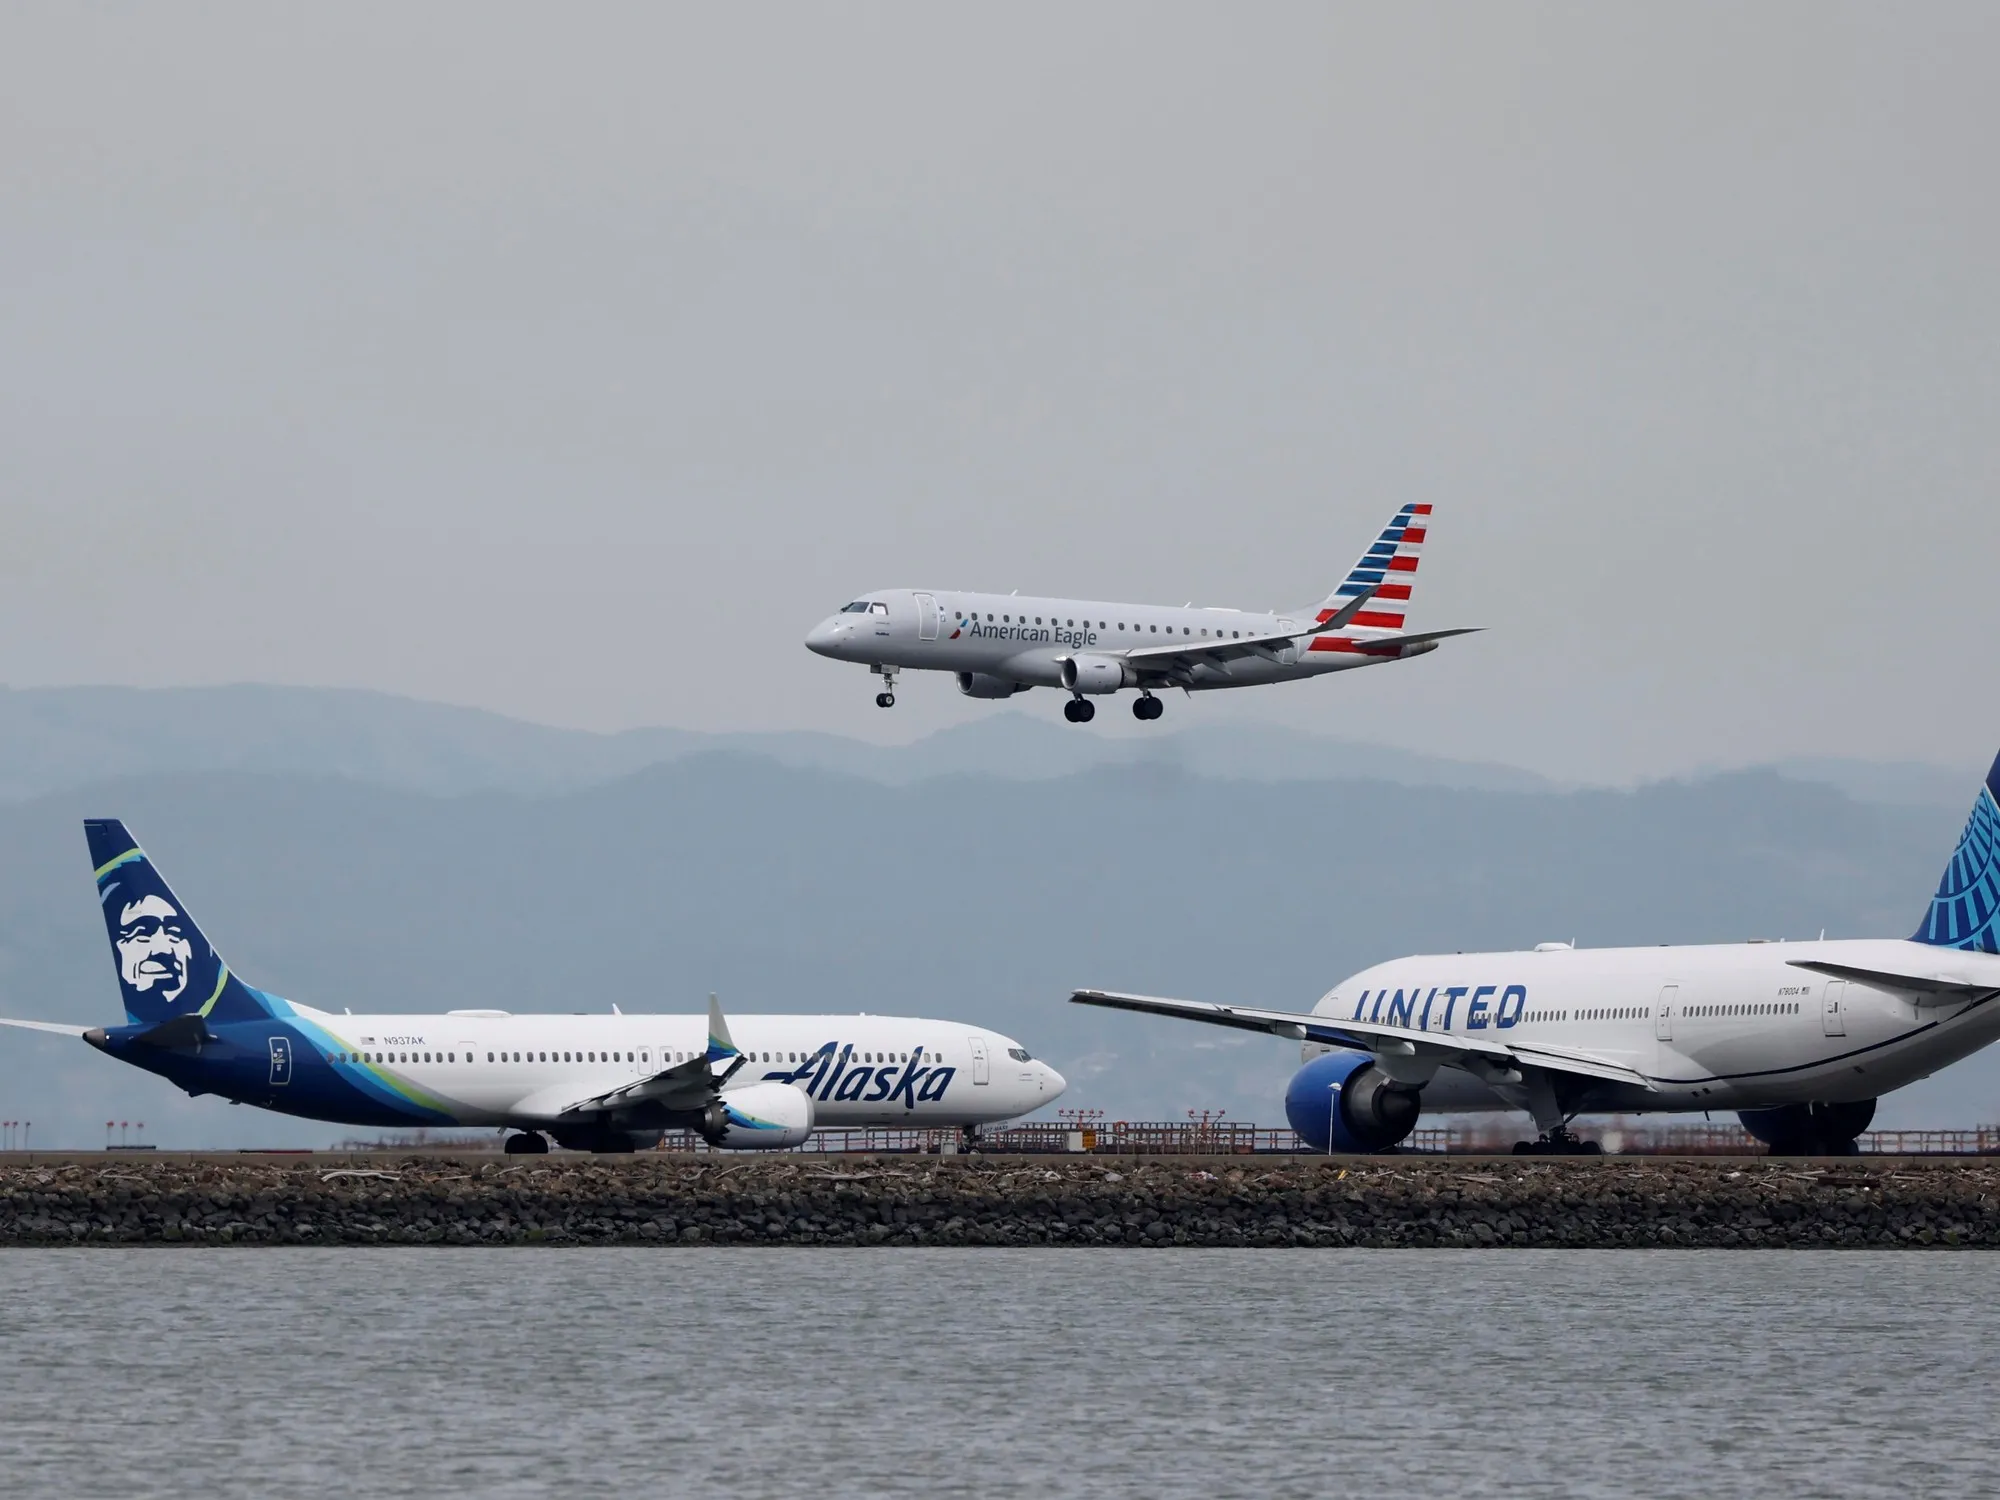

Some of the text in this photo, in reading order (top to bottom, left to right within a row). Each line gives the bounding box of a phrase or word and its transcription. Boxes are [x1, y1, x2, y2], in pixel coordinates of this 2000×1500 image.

[969, 621, 1097, 649] American Eagle
[1354, 984, 1527, 1031] UNITED
[383, 1036, 426, 1045] N937AK
[760, 1040, 957, 1110] Alaska
